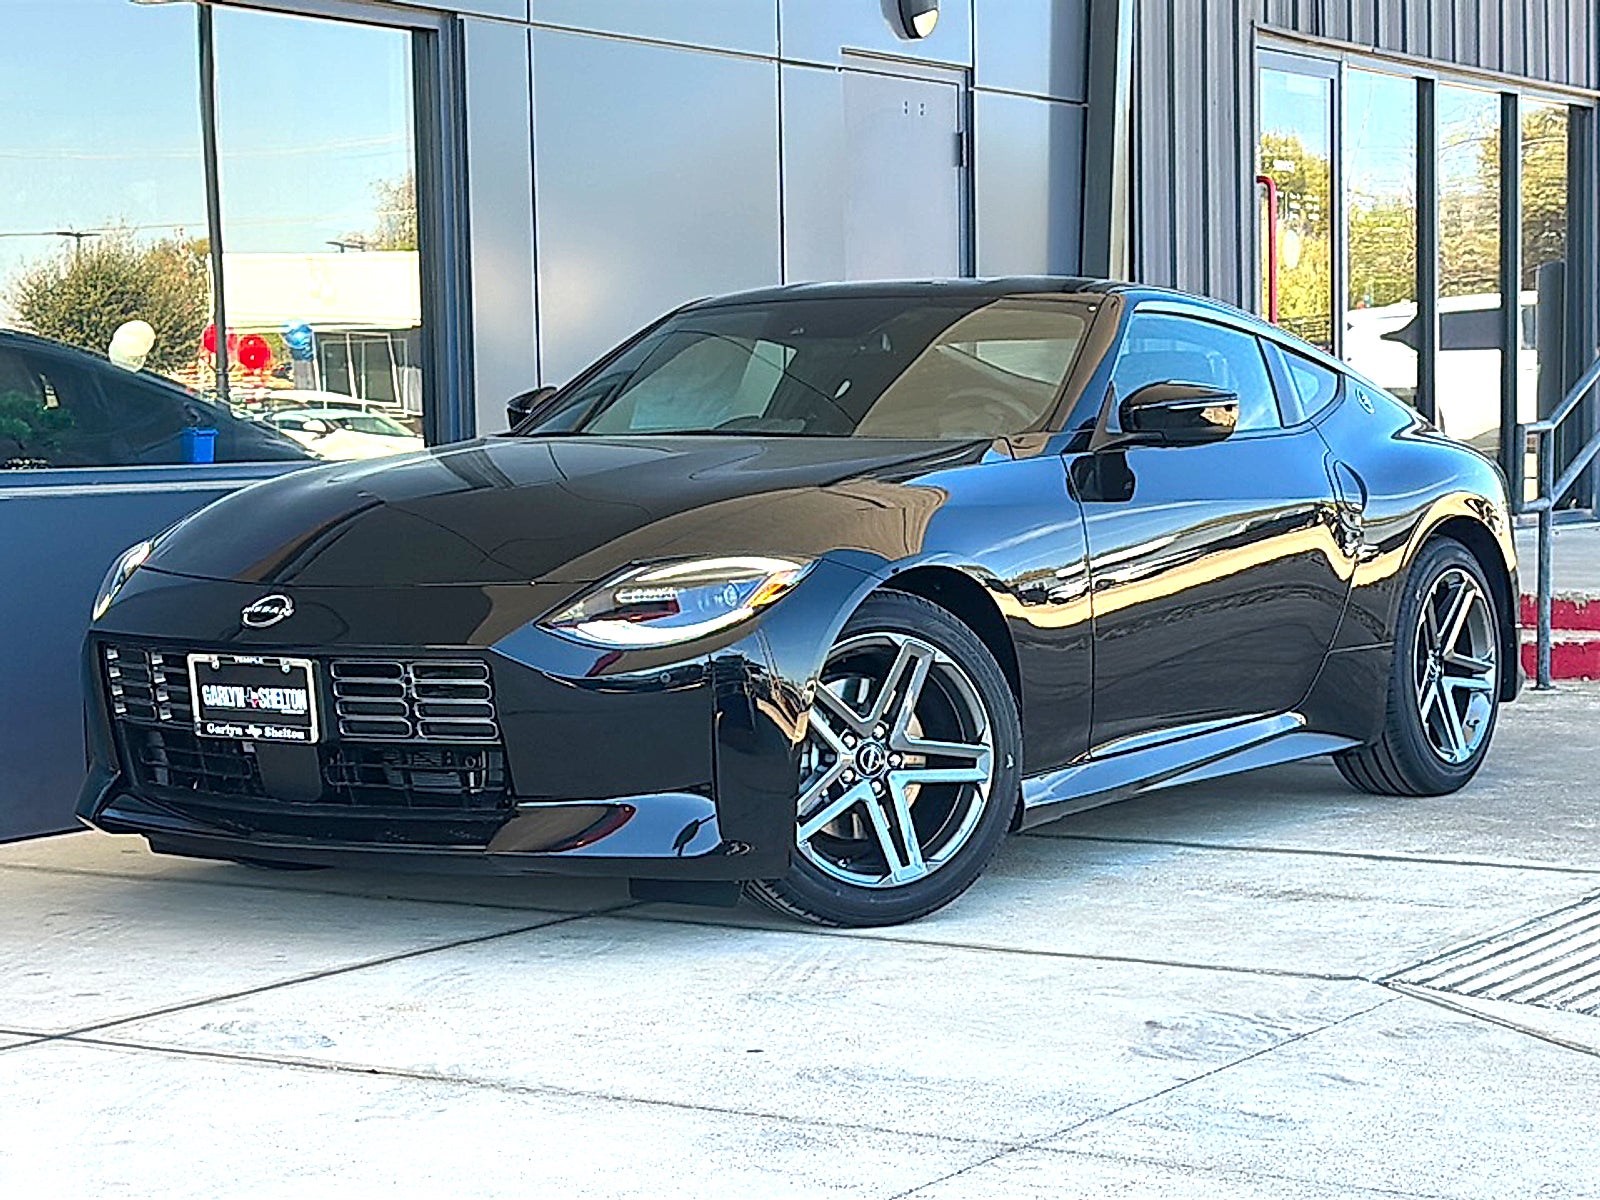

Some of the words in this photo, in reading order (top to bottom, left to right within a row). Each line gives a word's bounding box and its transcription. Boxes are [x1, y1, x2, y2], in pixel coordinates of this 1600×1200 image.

[201, 685, 246, 708] GARLYN
[258, 687, 308, 711] SHELTON
[264, 726, 305, 740] Shelton
